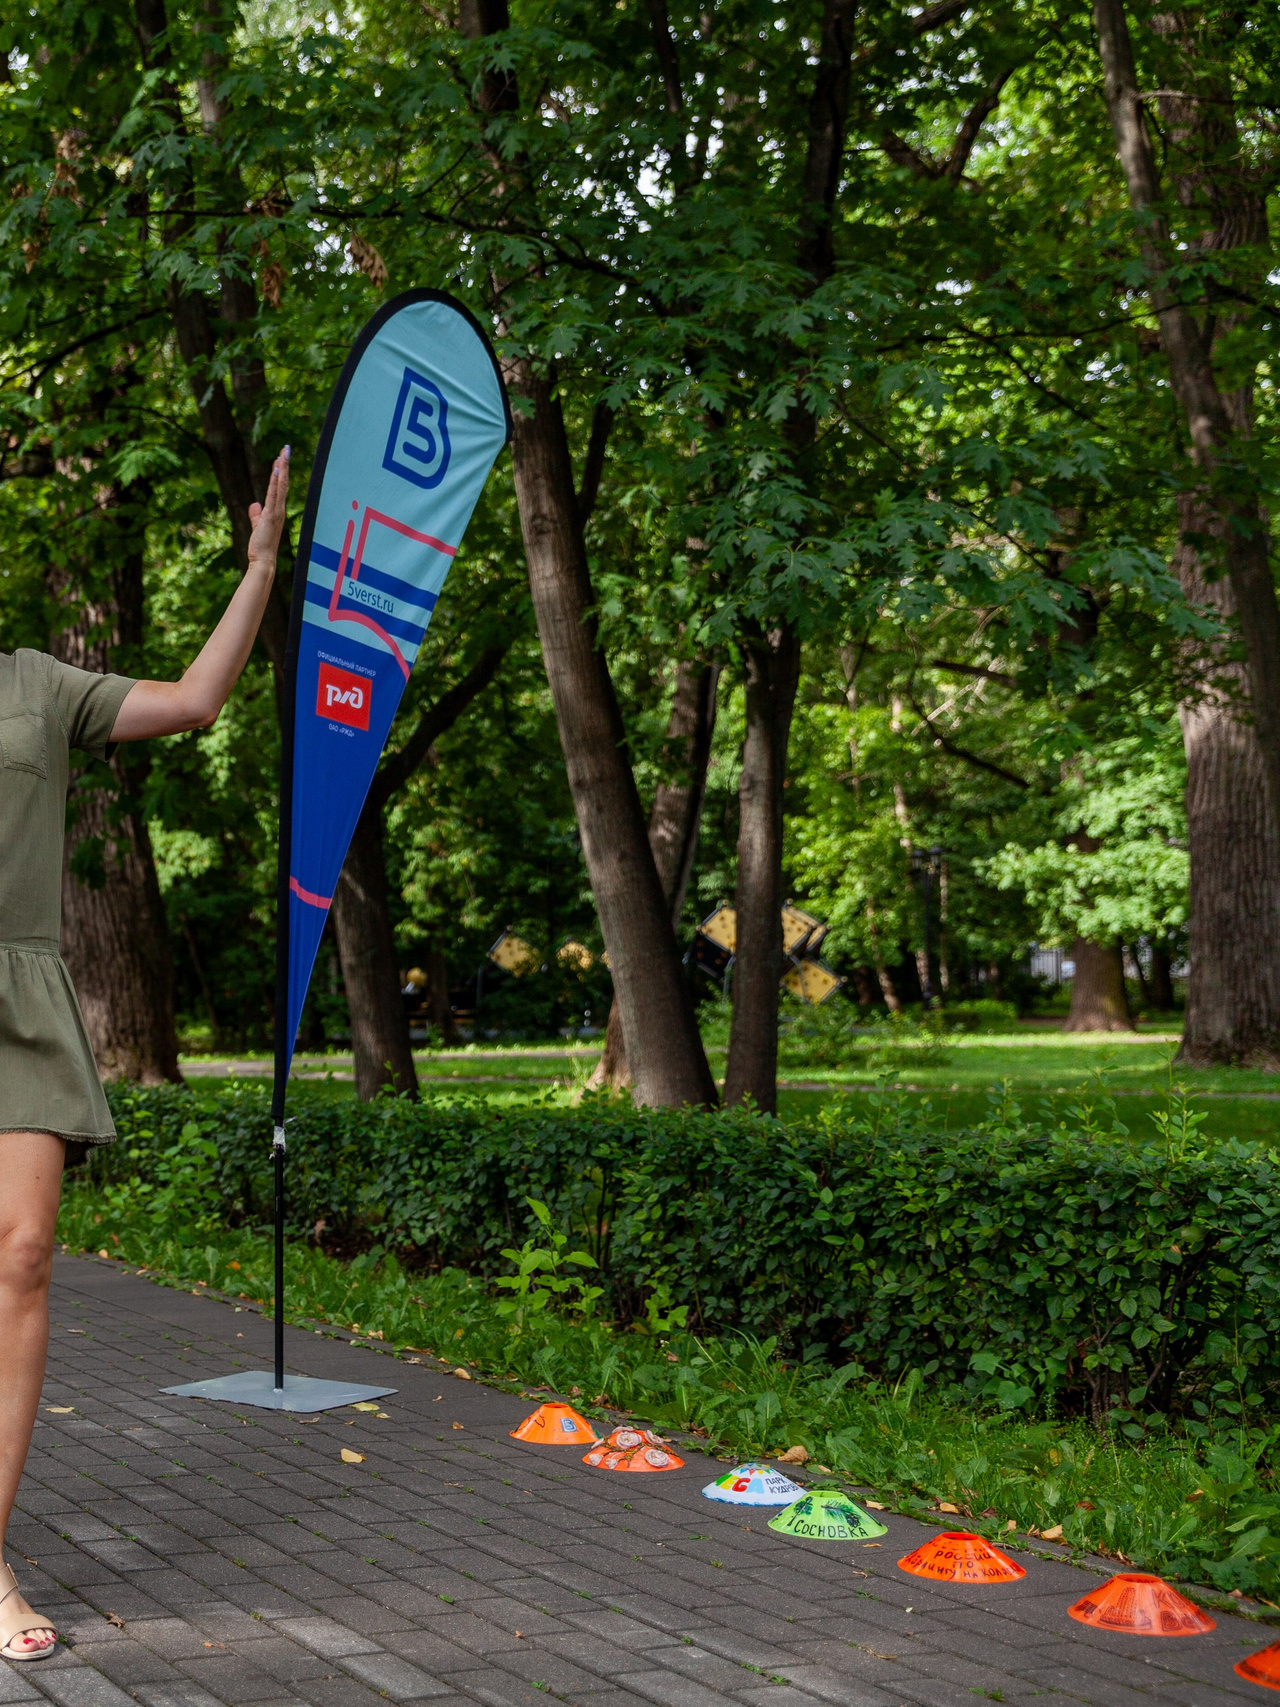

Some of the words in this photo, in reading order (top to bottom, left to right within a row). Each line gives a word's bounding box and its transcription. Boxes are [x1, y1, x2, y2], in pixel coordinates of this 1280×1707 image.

[348, 581, 395, 613] 5verst.ru
[355, 664, 377, 677] ПАРТНЕР
[793, 1519, 869, 1539] СОСНОВКА
